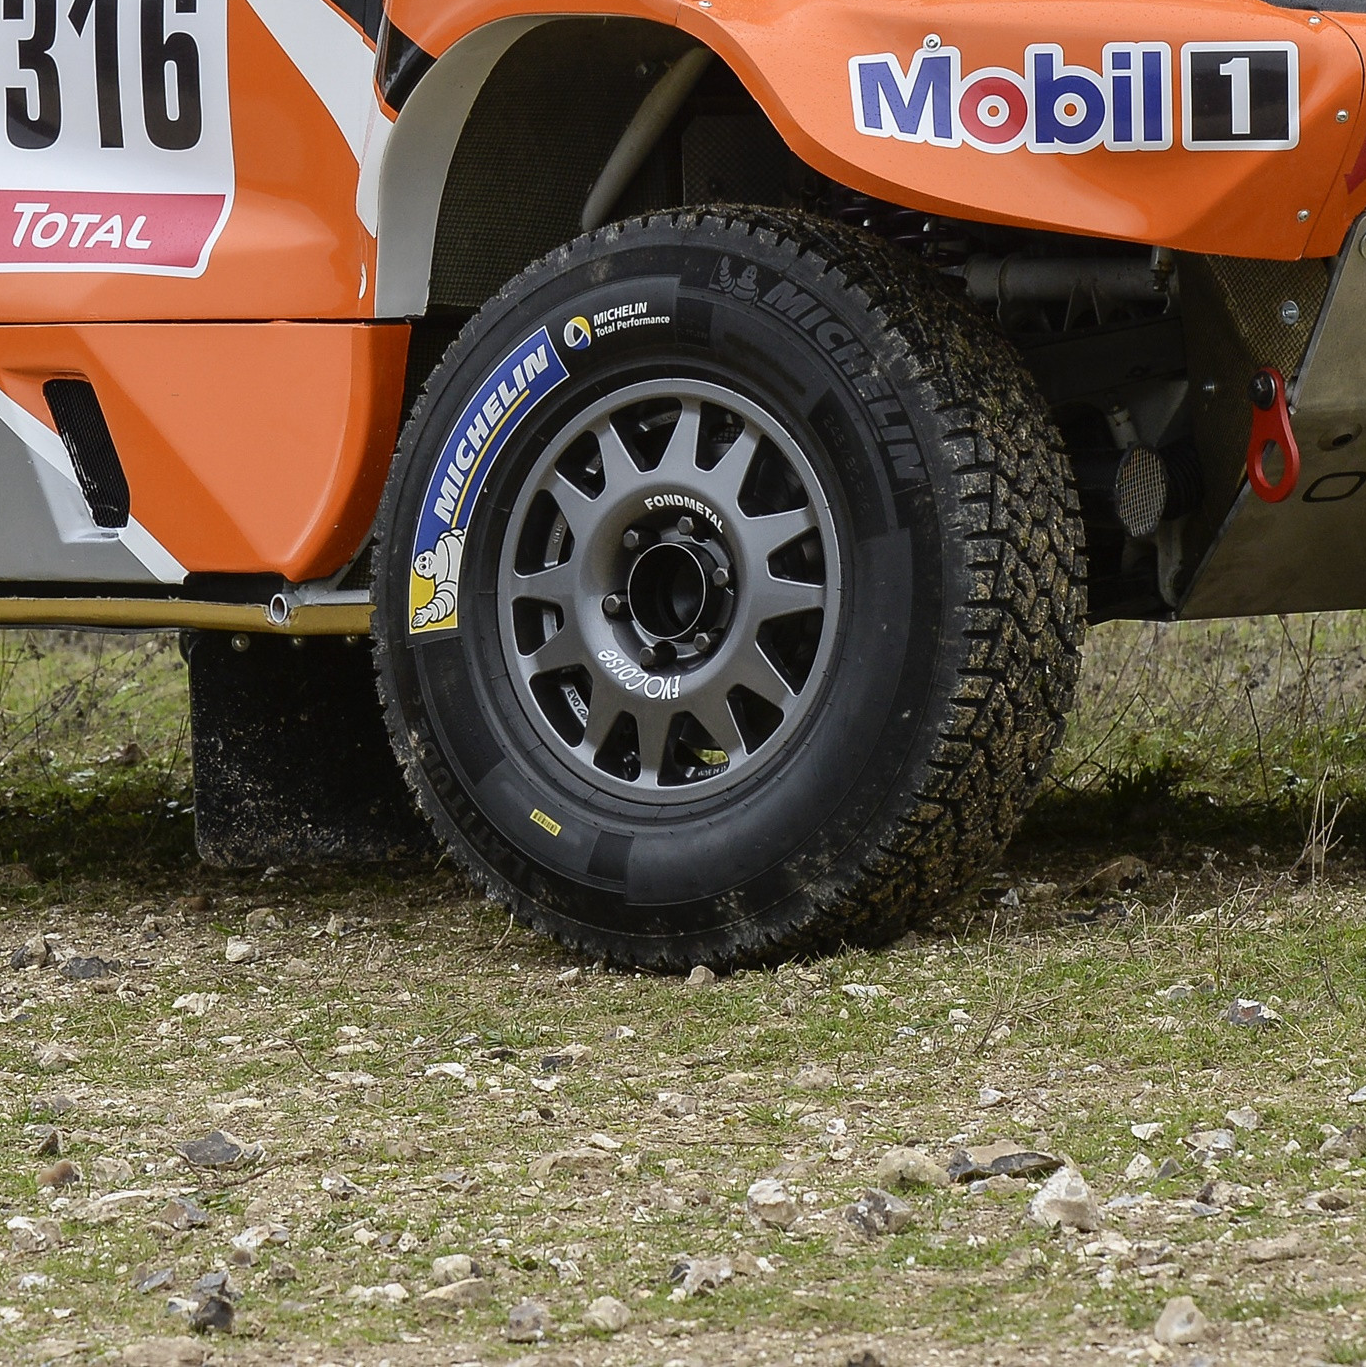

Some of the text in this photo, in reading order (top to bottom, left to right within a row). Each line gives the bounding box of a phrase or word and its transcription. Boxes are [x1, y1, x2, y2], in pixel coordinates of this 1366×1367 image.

[858, 50, 1164, 145] Mobil
[11, 203, 154, 250] TOTAL
[593, 301, 648, 327] MICHELIN
[595, 315, 671, 338] Total Performance
[761, 280, 928, 480] MICHELIN
[434, 344, 550, 525] MICHELIN
[643, 493, 725, 534] FONDMETAL
[567, 688, 582, 708] EVO
